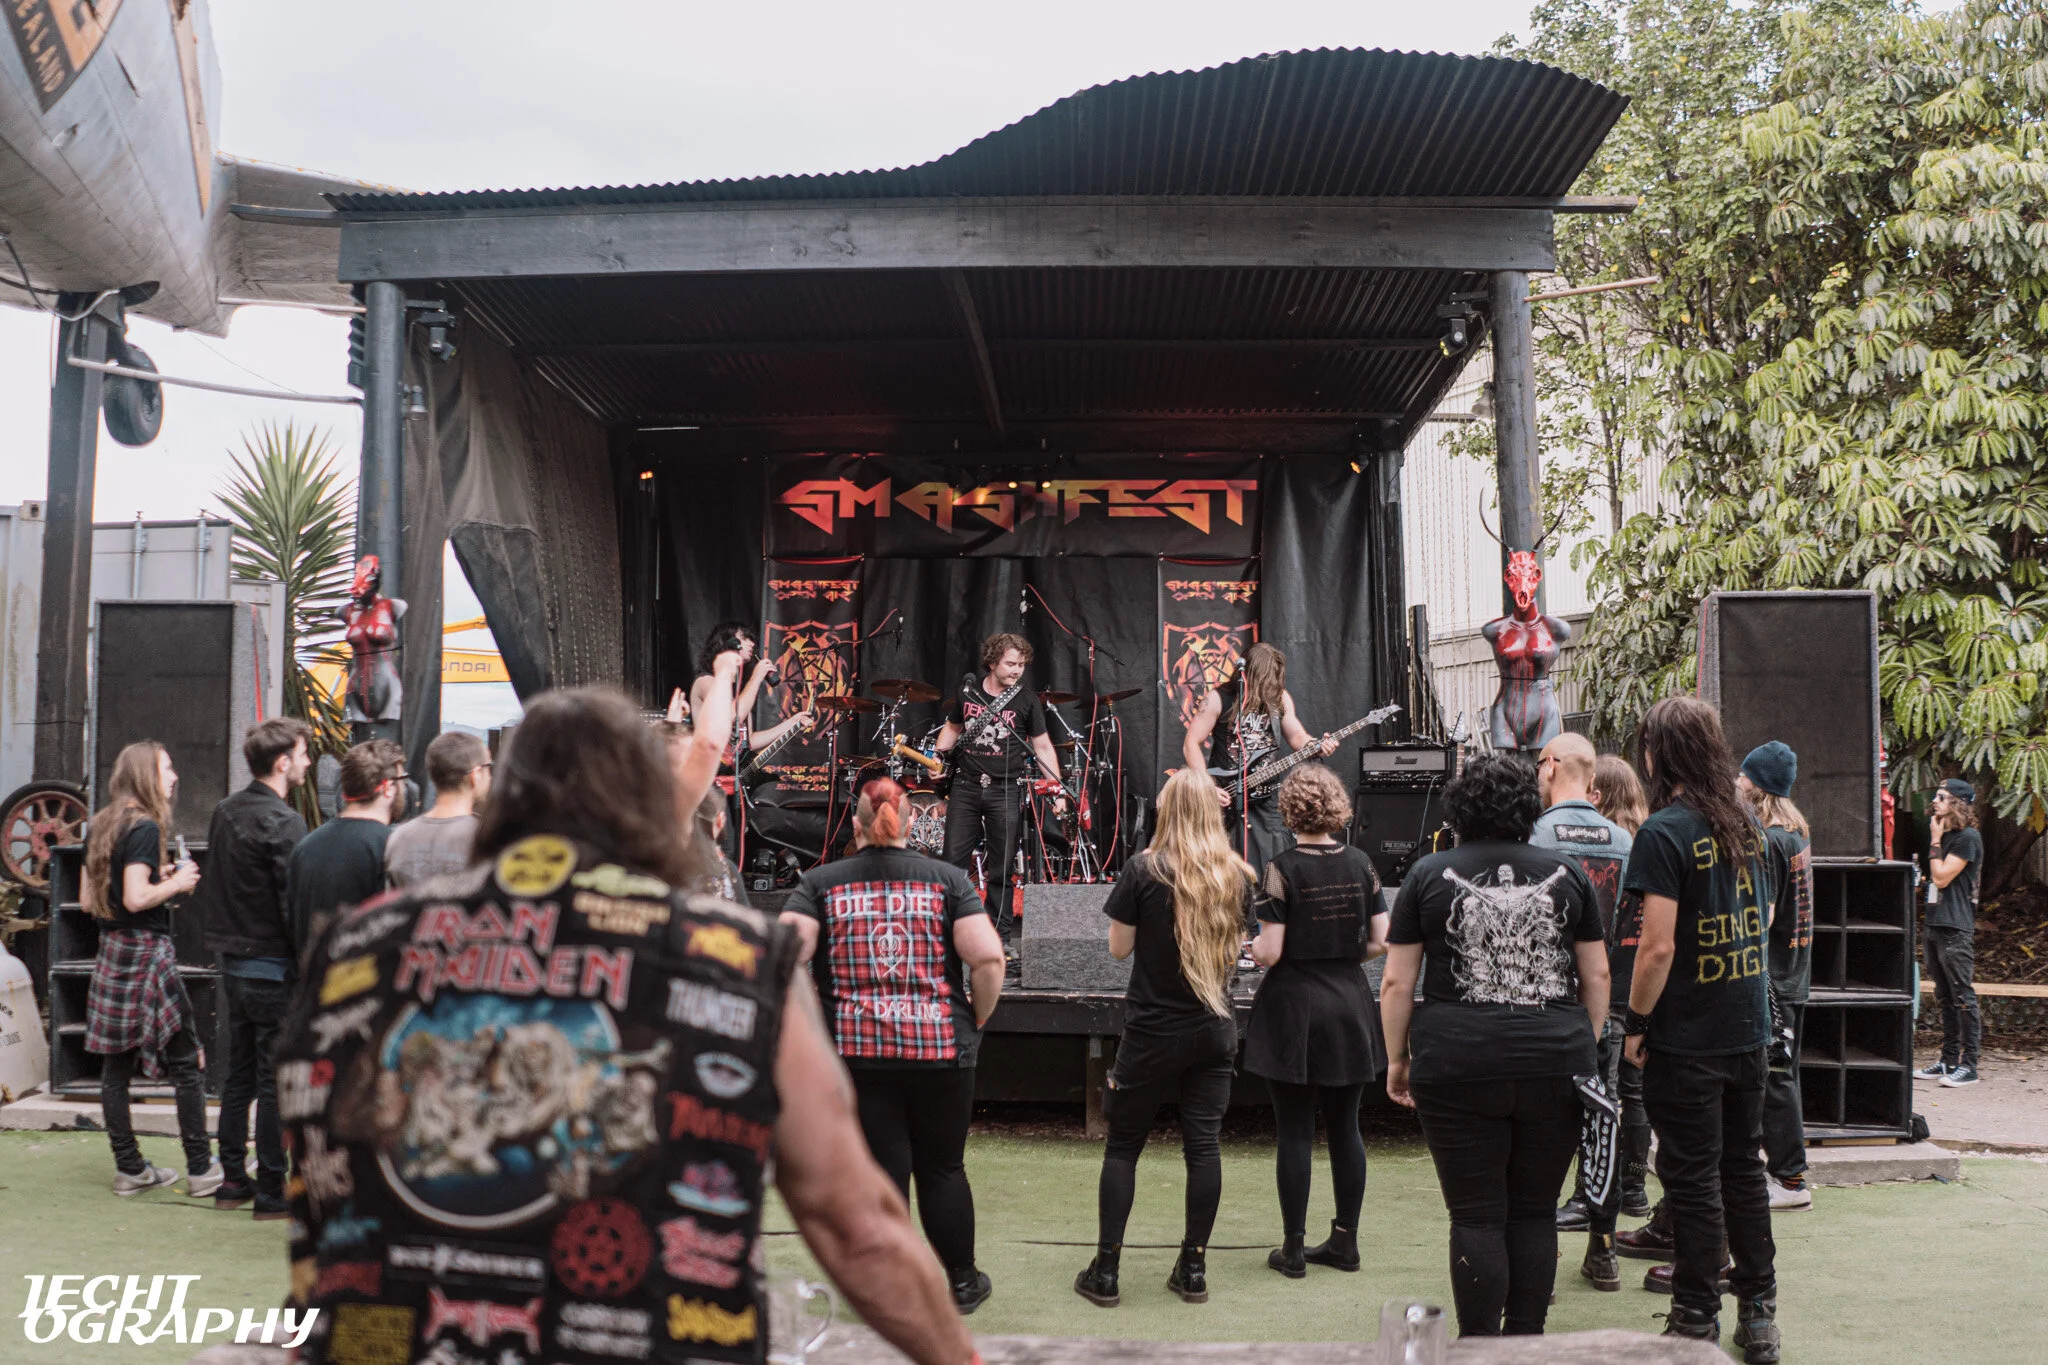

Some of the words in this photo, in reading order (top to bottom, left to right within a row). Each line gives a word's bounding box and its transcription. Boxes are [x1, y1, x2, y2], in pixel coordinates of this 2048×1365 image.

[779, 477, 1257, 535] SMASHFEST
[767, 579, 860, 591] SMASHFEST
[1165, 580, 1259, 592] SMASHFEST
[442, 662, 491, 673] UNDAI
[1736, 866, 1753, 899] A
[835, 893, 880, 918] DIE
[889, 893, 933, 916] DIE
[412, 900, 561, 952] IRON
[393, 943, 635, 1011] MAIDEN
[874, 1001, 943, 1021] DARLING
